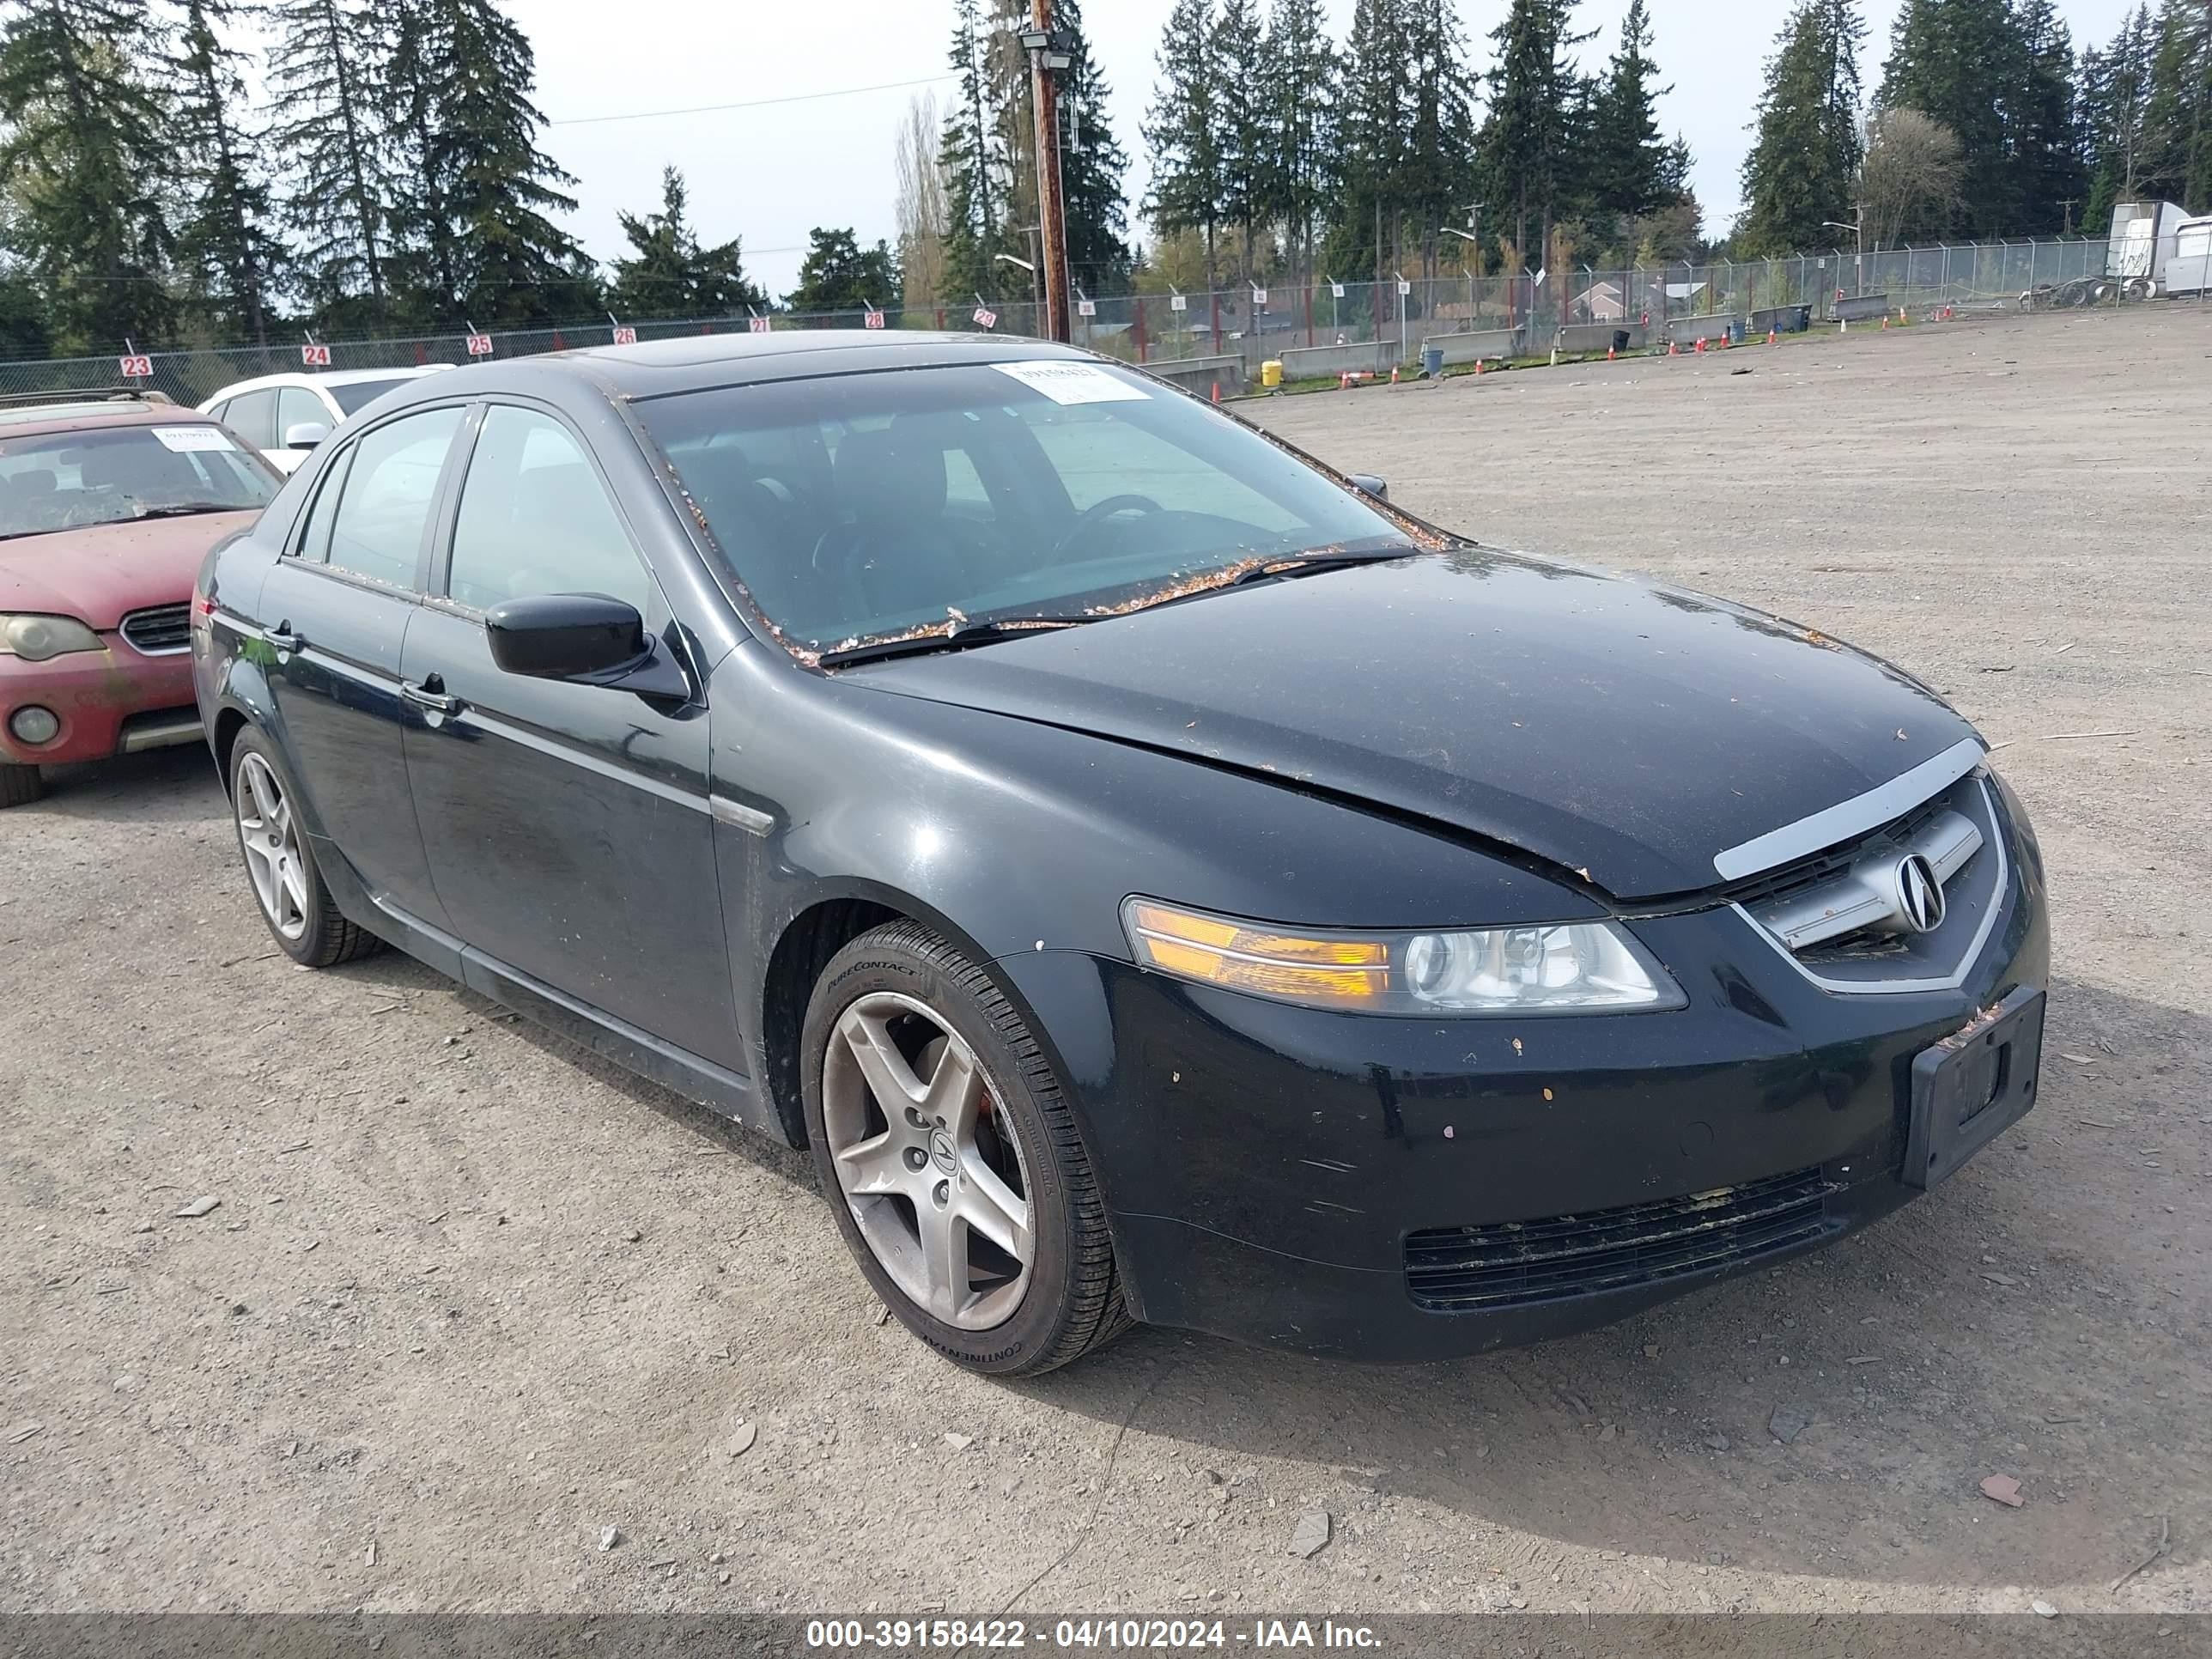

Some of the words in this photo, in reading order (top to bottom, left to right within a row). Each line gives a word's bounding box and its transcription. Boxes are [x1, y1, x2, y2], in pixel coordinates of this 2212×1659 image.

[867, 314, 882, 327] 28
[975, 310, 994, 325] 29
[753, 319, 766, 332] 27
[616, 330, 635, 343] 26
[470, 337, 489, 353] 25
[305, 348, 327, 363] 24
[124, 357, 149, 375] 23
